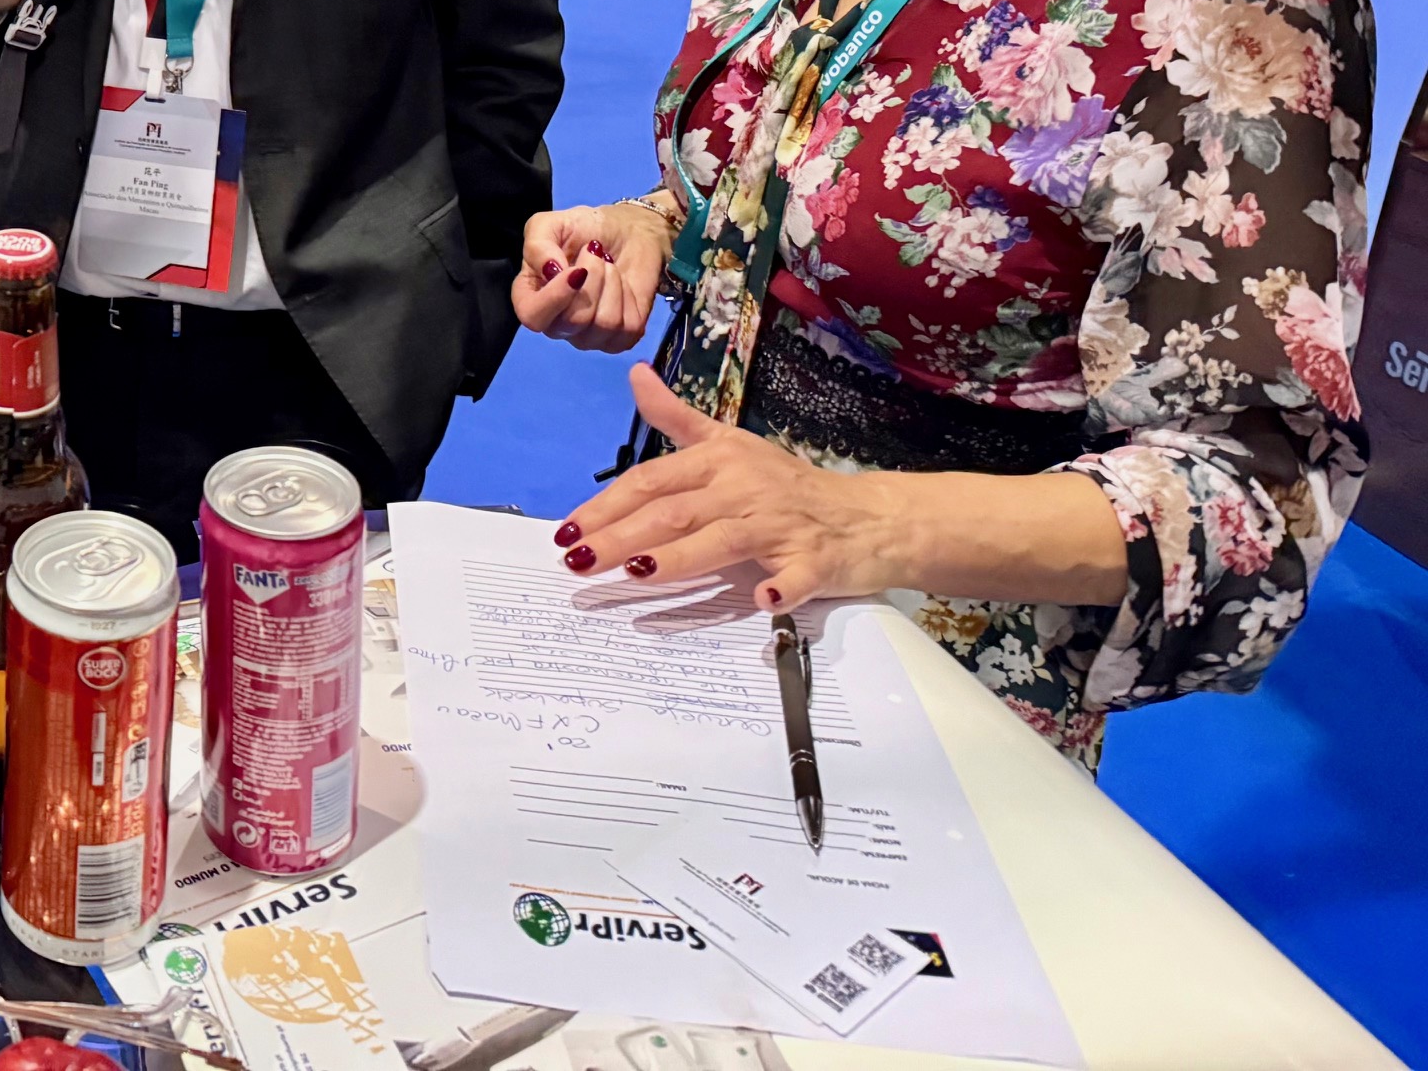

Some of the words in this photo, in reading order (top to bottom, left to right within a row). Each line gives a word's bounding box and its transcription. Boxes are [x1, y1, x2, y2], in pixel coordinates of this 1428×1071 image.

[819, 9, 883, 89] vobanco
[83, 658, 121, 670] SUPER
[85, 668, 120, 679] BOCK
[174, 866, 220, 890] MUNDO
